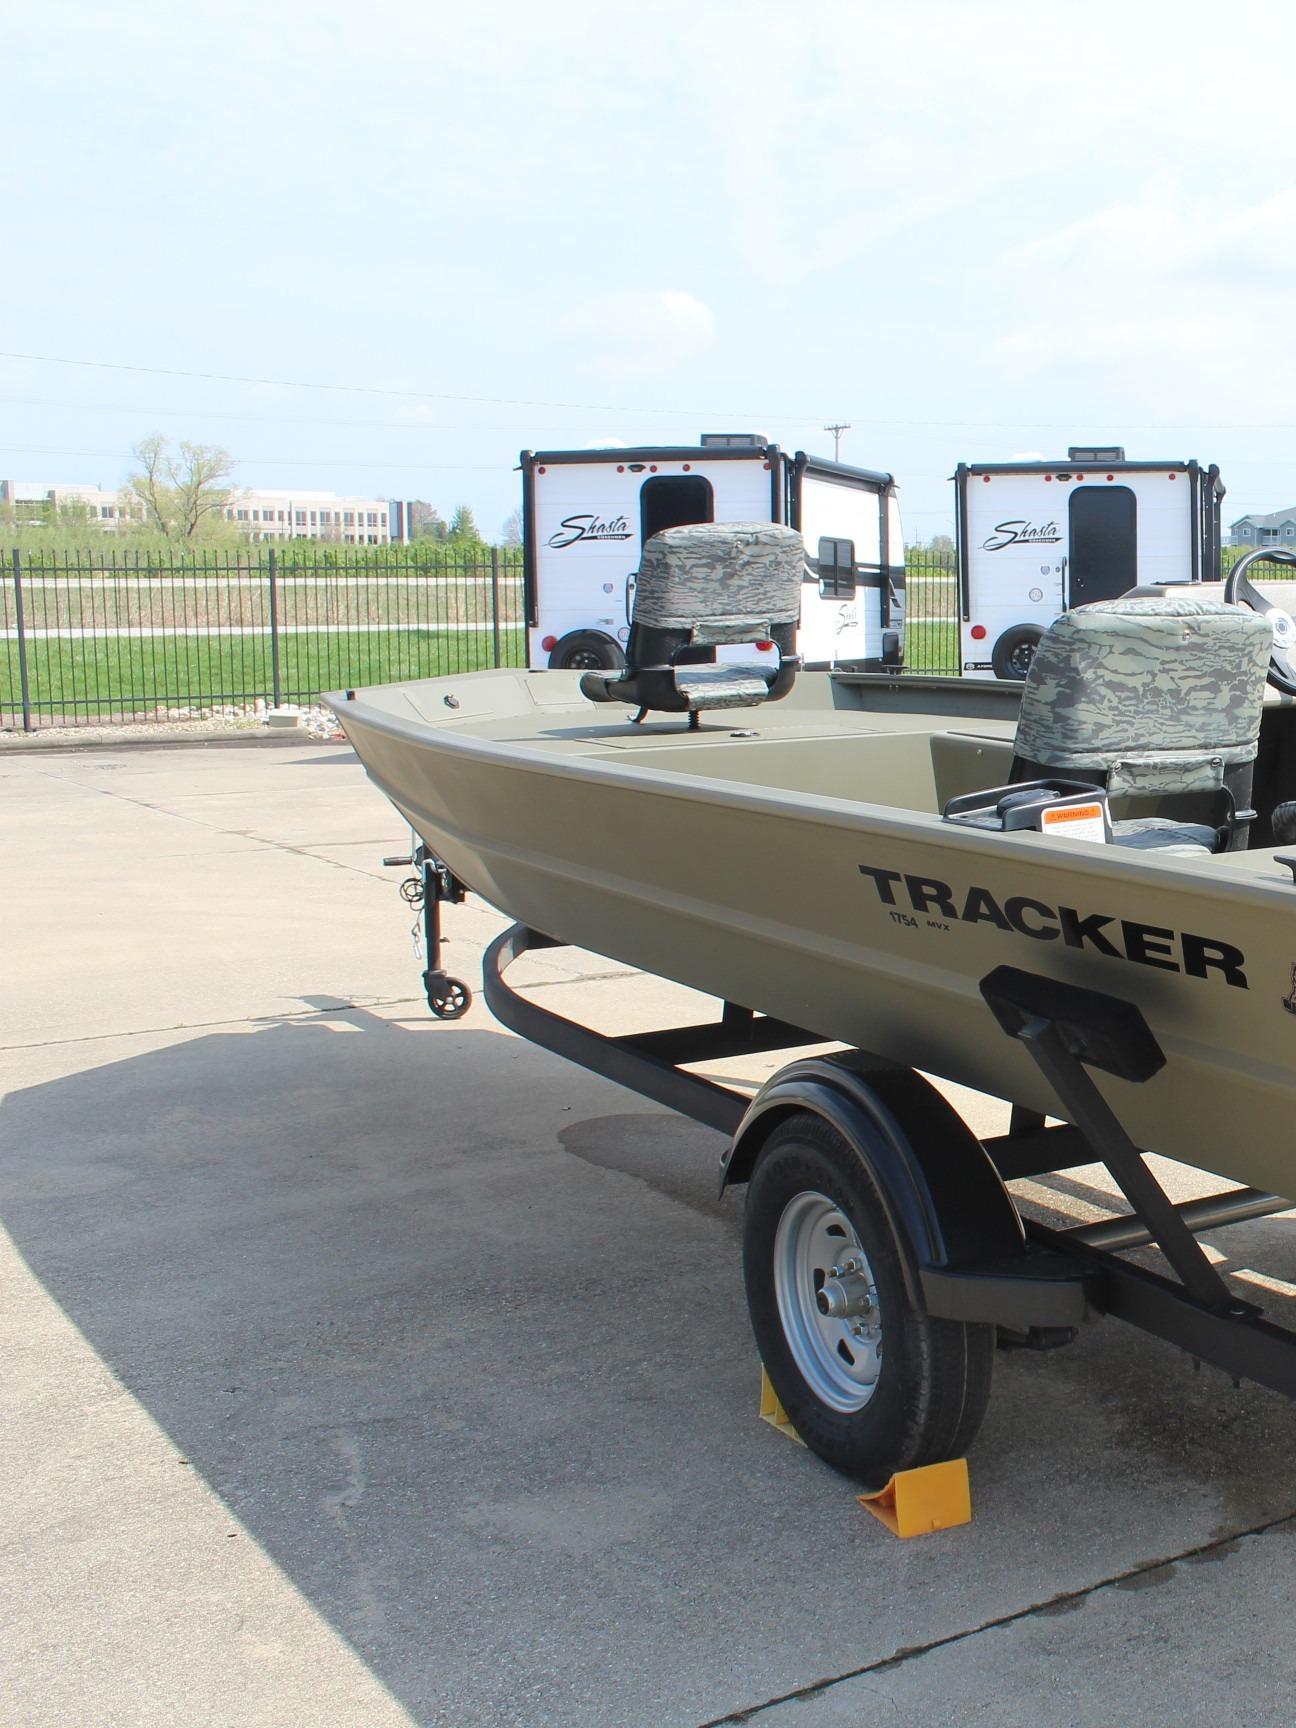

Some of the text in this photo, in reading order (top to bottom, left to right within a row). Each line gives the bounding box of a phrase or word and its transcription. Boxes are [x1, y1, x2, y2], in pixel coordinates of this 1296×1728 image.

[543, 514, 632, 549] Shasta
[978, 520, 1061, 551] Shasta
[858, 864, 1250, 990] TRACKER
[889, 911, 919, 929] 1754
